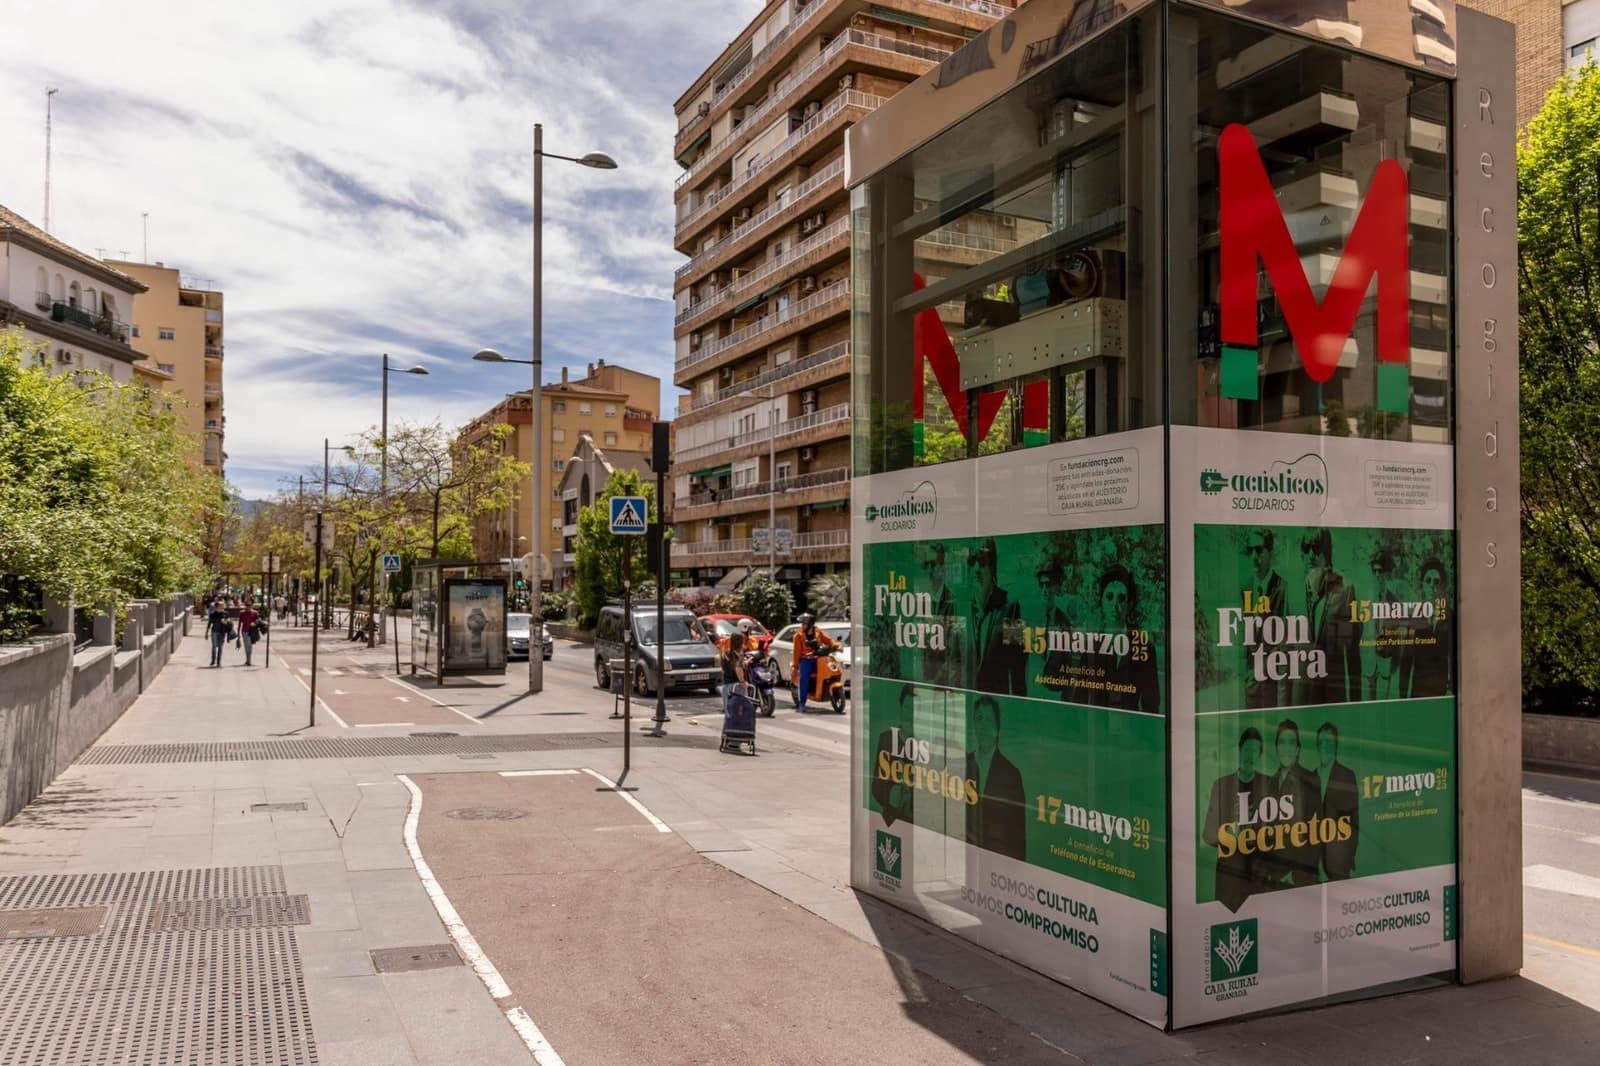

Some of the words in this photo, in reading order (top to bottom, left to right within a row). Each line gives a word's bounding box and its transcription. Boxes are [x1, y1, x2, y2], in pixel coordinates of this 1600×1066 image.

[1219, 122, 1409, 413] M
[1231, 497, 1295, 511] SOLIDARIOS
[881, 519, 916, 531] SOLIDARIOS
[889, 571, 906, 591] La
[874, 584, 933, 618] Fron
[1243, 590, 1271, 614] La
[1349, 600, 1371, 623] 15
[1372, 601, 1433, 619] marzo
[895, 617, 946, 650] tera
[1023, 627, 1047, 653] 15
[1048, 630, 1130, 656] marzo
[1216, 607, 1310, 647] Fron
[1097, 667, 1105, 677] de
[1252, 643, 1328, 682] tera
[1034, 674, 1068, 685] Asociación
[1070, 678, 1104, 690] Parkinson
[1105, 681, 1136, 693] Granada
[890, 726, 930, 765] Los
[878, 750, 980, 806] Secretos
[1362, 775, 1384, 799] 17
[1385, 772, 1435, 796] mayo
[1036, 794, 1062, 824] 17
[1063, 803, 1132, 844] mayo
[1237, 791, 1295, 826] Los
[1218, 813, 1352, 859] Secretos
[1049, 844, 1078, 861] Teléfono
[1089, 855, 1096, 866] la
[1097, 859, 1136, 879] Esperanza
[990, 871, 1035, 901] SOMOS
[1037, 888, 1098, 925] CULTURA
[1342, 897, 1383, 915] SOMOS
[1383, 889, 1430, 908] CULTURA
[1005, 903, 1099, 953] COMPROMISO
[1313, 925, 1355, 944] SOMOS
[1355, 911, 1431, 937] COMPROMISO
[1204, 982, 1226, 995] CAJA
[1228, 976, 1259, 991] RURAL
[1216, 989, 1247, 1001] GRANADA
